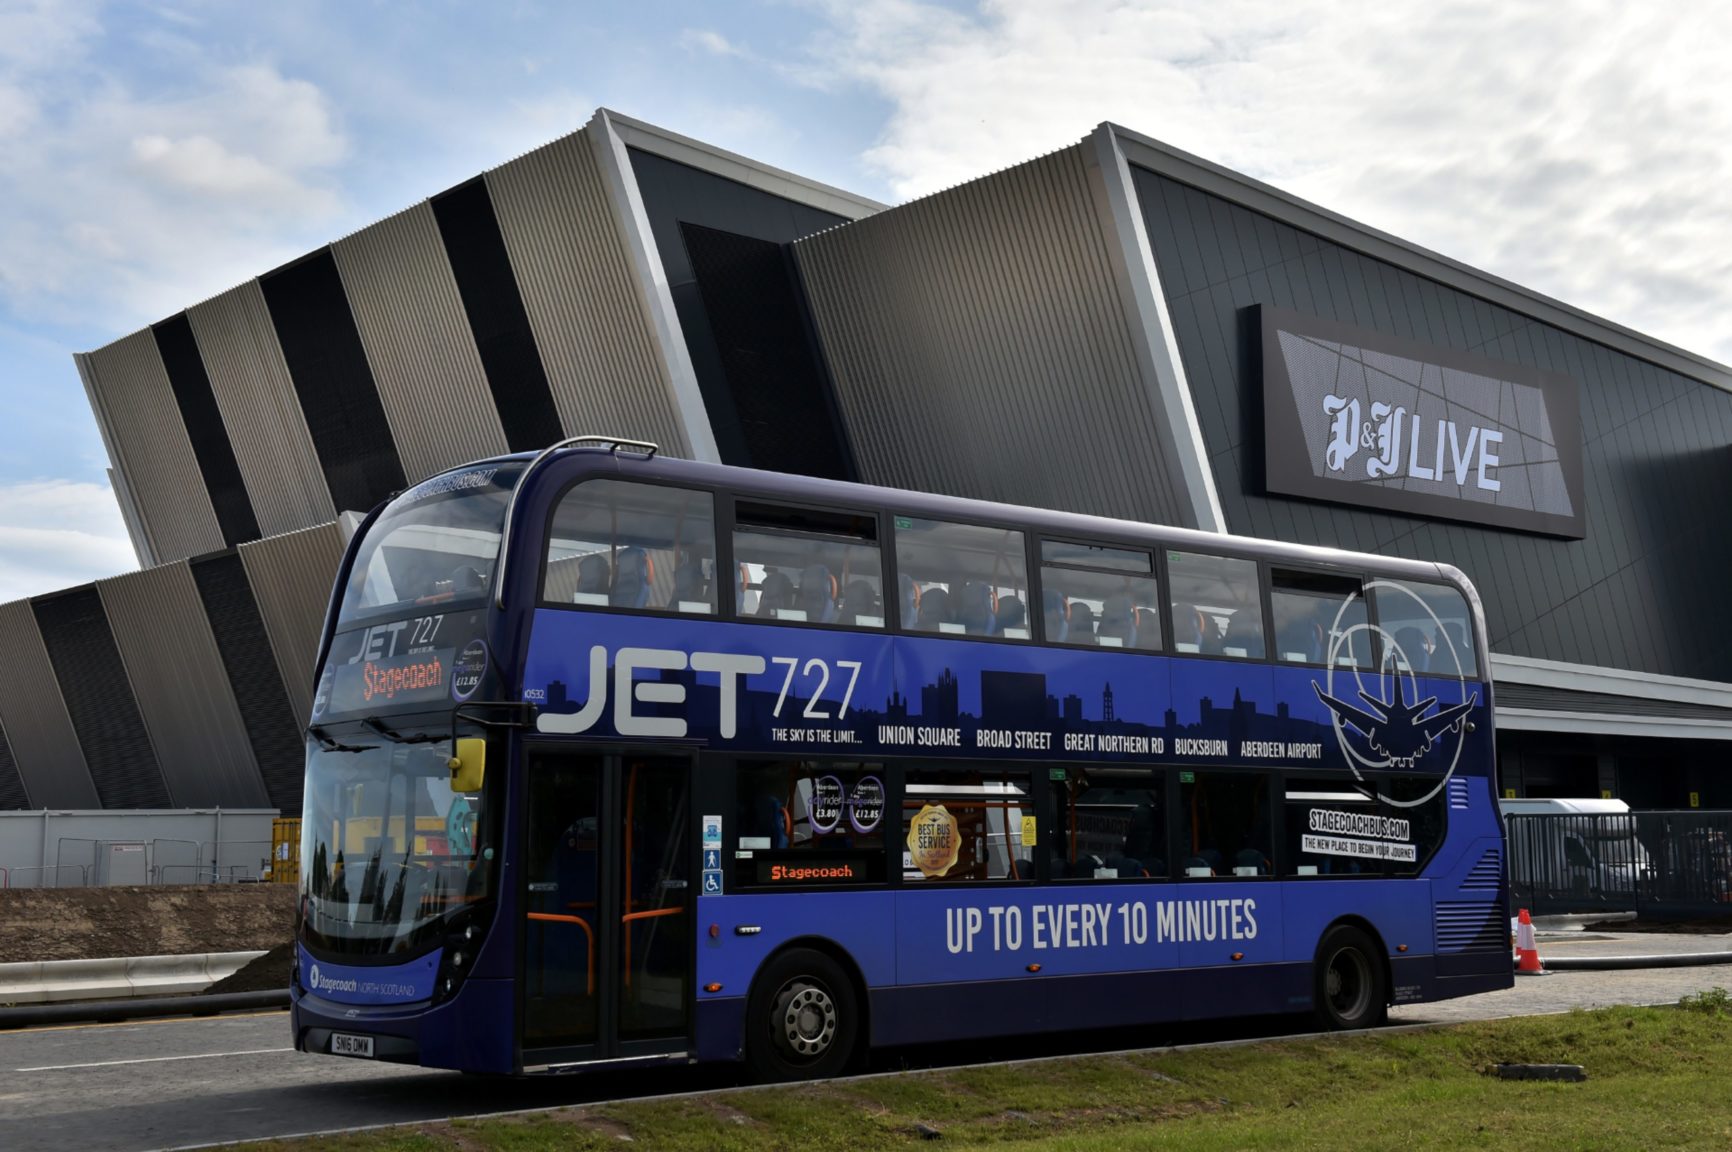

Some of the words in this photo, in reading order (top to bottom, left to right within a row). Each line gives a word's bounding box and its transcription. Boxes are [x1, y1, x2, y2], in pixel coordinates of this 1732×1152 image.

[1409, 414, 1503, 492] LIVE
[349, 620, 408, 665] JET
[410, 614, 445, 645] 727
[363, 655, 443, 701] Stagecoach
[536, 645, 766, 739] JET
[771, 656, 863, 720] 727
[771, 728, 788, 741] THE
[789, 728, 805, 742] SKY
[806, 729, 815, 742] IS
[816, 729, 831, 743] THE
[833, 730, 863, 744] LIMIT...
[878, 725, 914, 745] UNION
[917, 726, 961, 747] SQUARE
[976, 729, 1013, 748] BROAD
[1014, 731, 1052, 750] STREET
[1064, 733, 1095, 751] GREAT
[1098, 734, 1149, 753] NORTHERN
[1151, 737, 1164, 754] RD
[1175, 738, 1228, 756] BUCKSBURN
[1241, 741, 1285, 758] ABERDEEN
[1287, 742, 1322, 759] AIRPORT
[918, 823, 935, 835] BEST
[936, 823, 951, 835] BUS
[1310, 809, 1409, 840] STAGECOACHBUS.COM
[918, 836, 951, 849] SERVICE
[1304, 837, 1316, 848] THE
[1317, 839, 1330, 850] NEW
[1331, 840, 1349, 853] PLACE
[1350, 842, 1358, 853] TO
[1358, 843, 1374, 855] BEGIN
[1375, 845, 1390, 857] YOUR
[1391, 846, 1415, 859] JOURNEY
[771, 864, 853, 880] Stagecoach
[946, 907, 982, 954] UP
[988, 905, 1022, 951] TO
[1032, 903, 1112, 949] EVERY
[1118, 901, 1148, 945] 10
[1156, 898, 1257, 943] MINUTES
[318, 974, 357, 994] Stagecoach
[357, 982, 380, 994] NORTH
[380, 983, 415, 996] SCOTLAND
